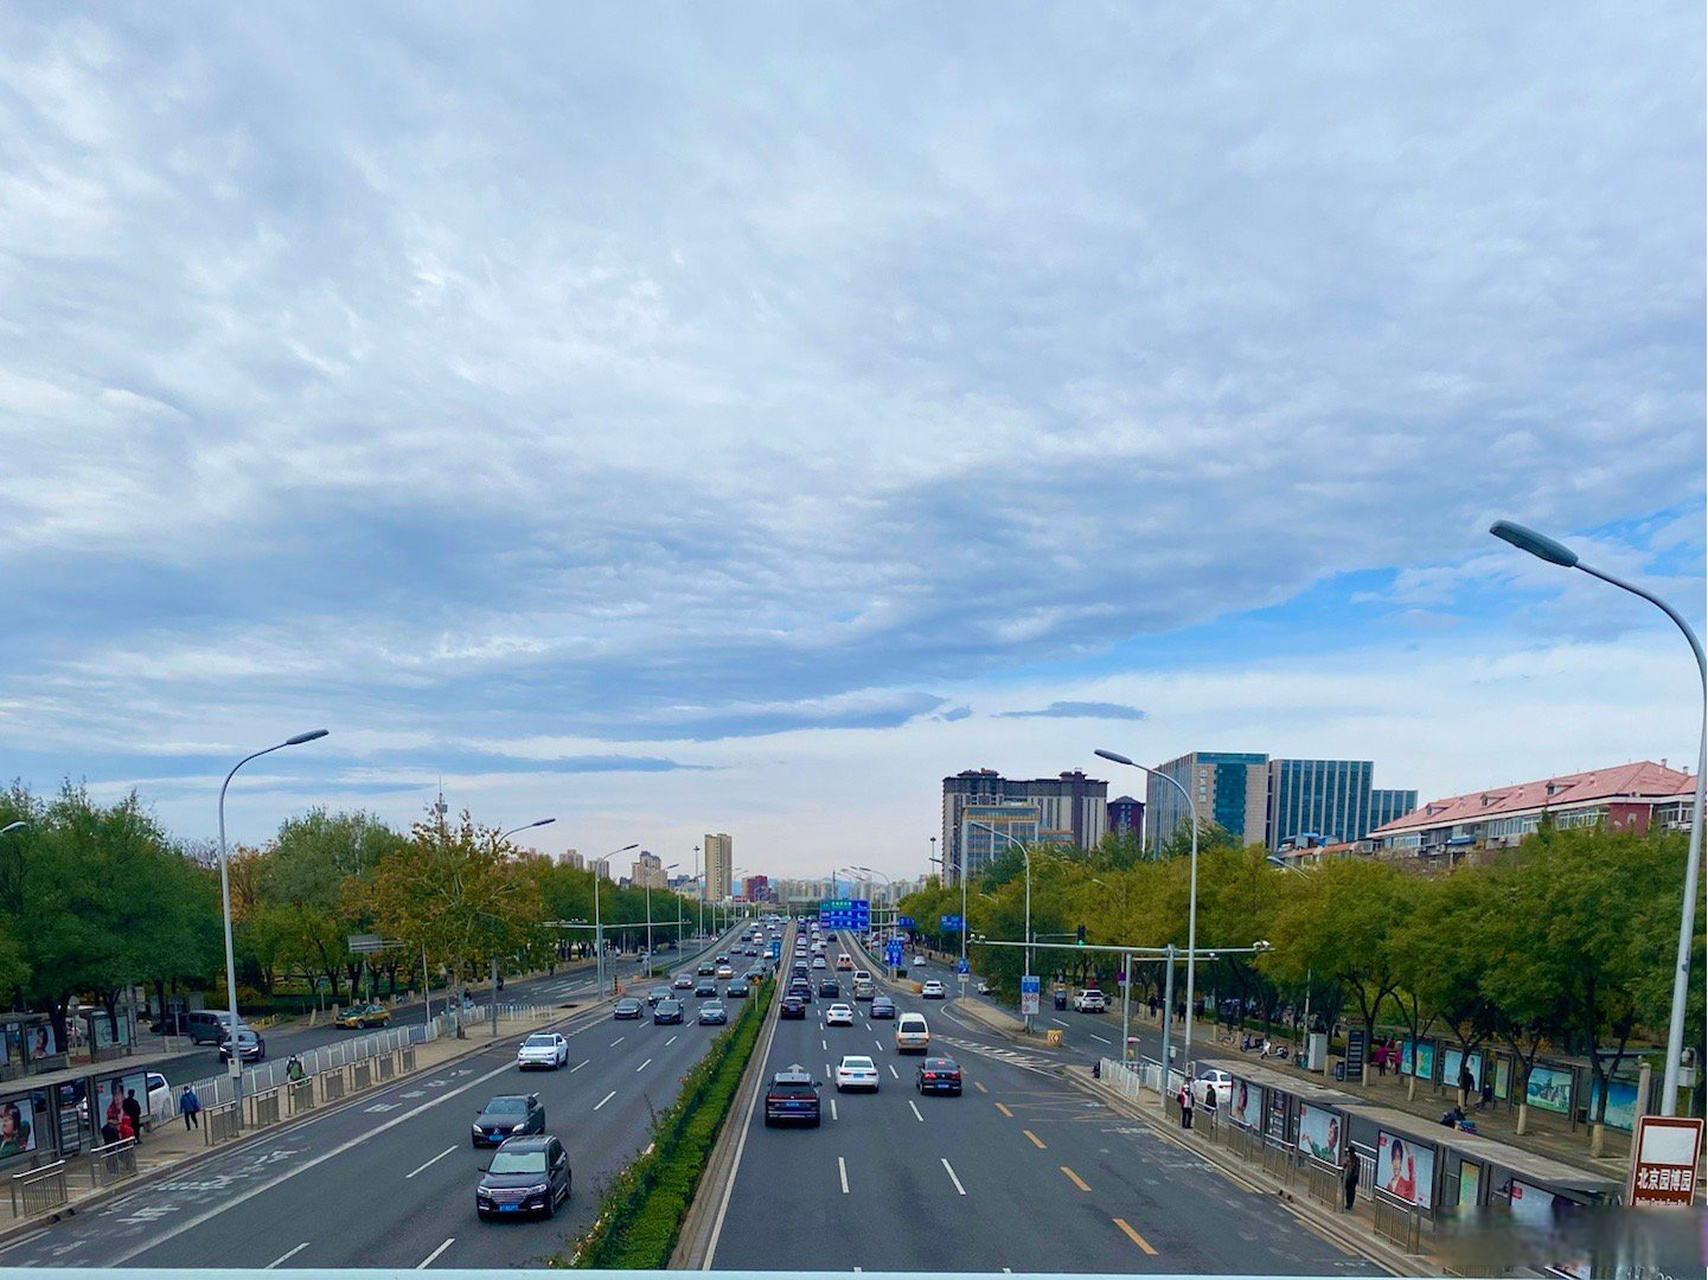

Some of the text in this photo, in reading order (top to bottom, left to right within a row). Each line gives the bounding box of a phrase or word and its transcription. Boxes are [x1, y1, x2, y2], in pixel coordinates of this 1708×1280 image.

[1637, 1167, 1693, 1191] 北京园博园
